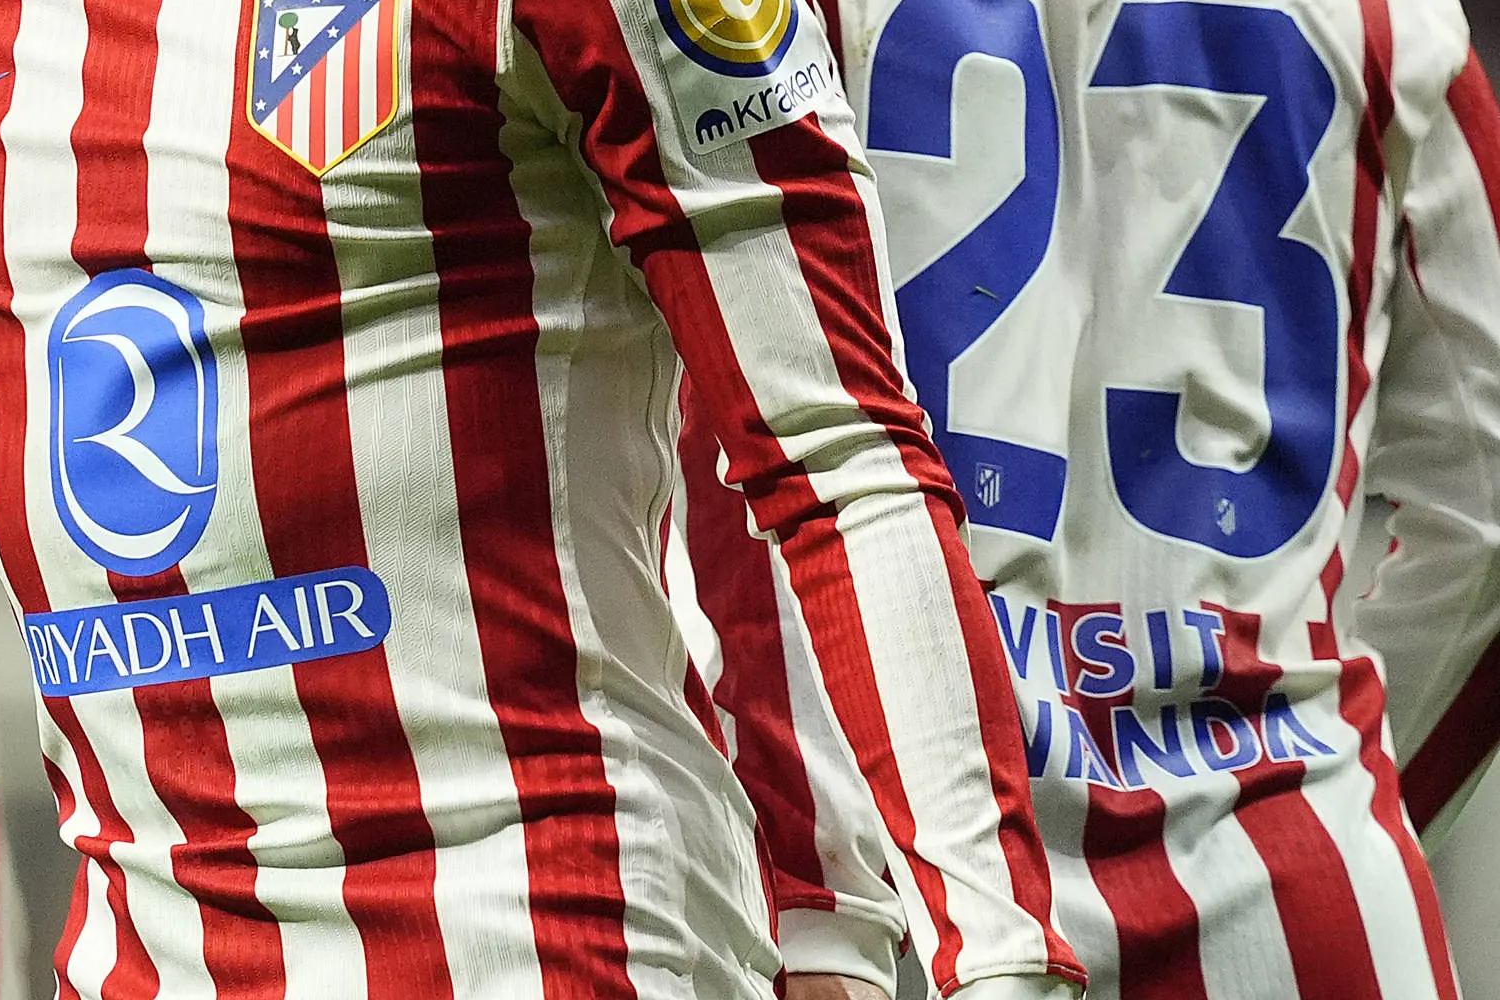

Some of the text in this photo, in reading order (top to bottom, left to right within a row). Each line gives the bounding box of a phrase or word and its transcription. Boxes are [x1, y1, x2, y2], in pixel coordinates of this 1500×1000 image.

[28, 579, 375, 686] RIYADH AIR
[989, 593, 1226, 696] VISIT
